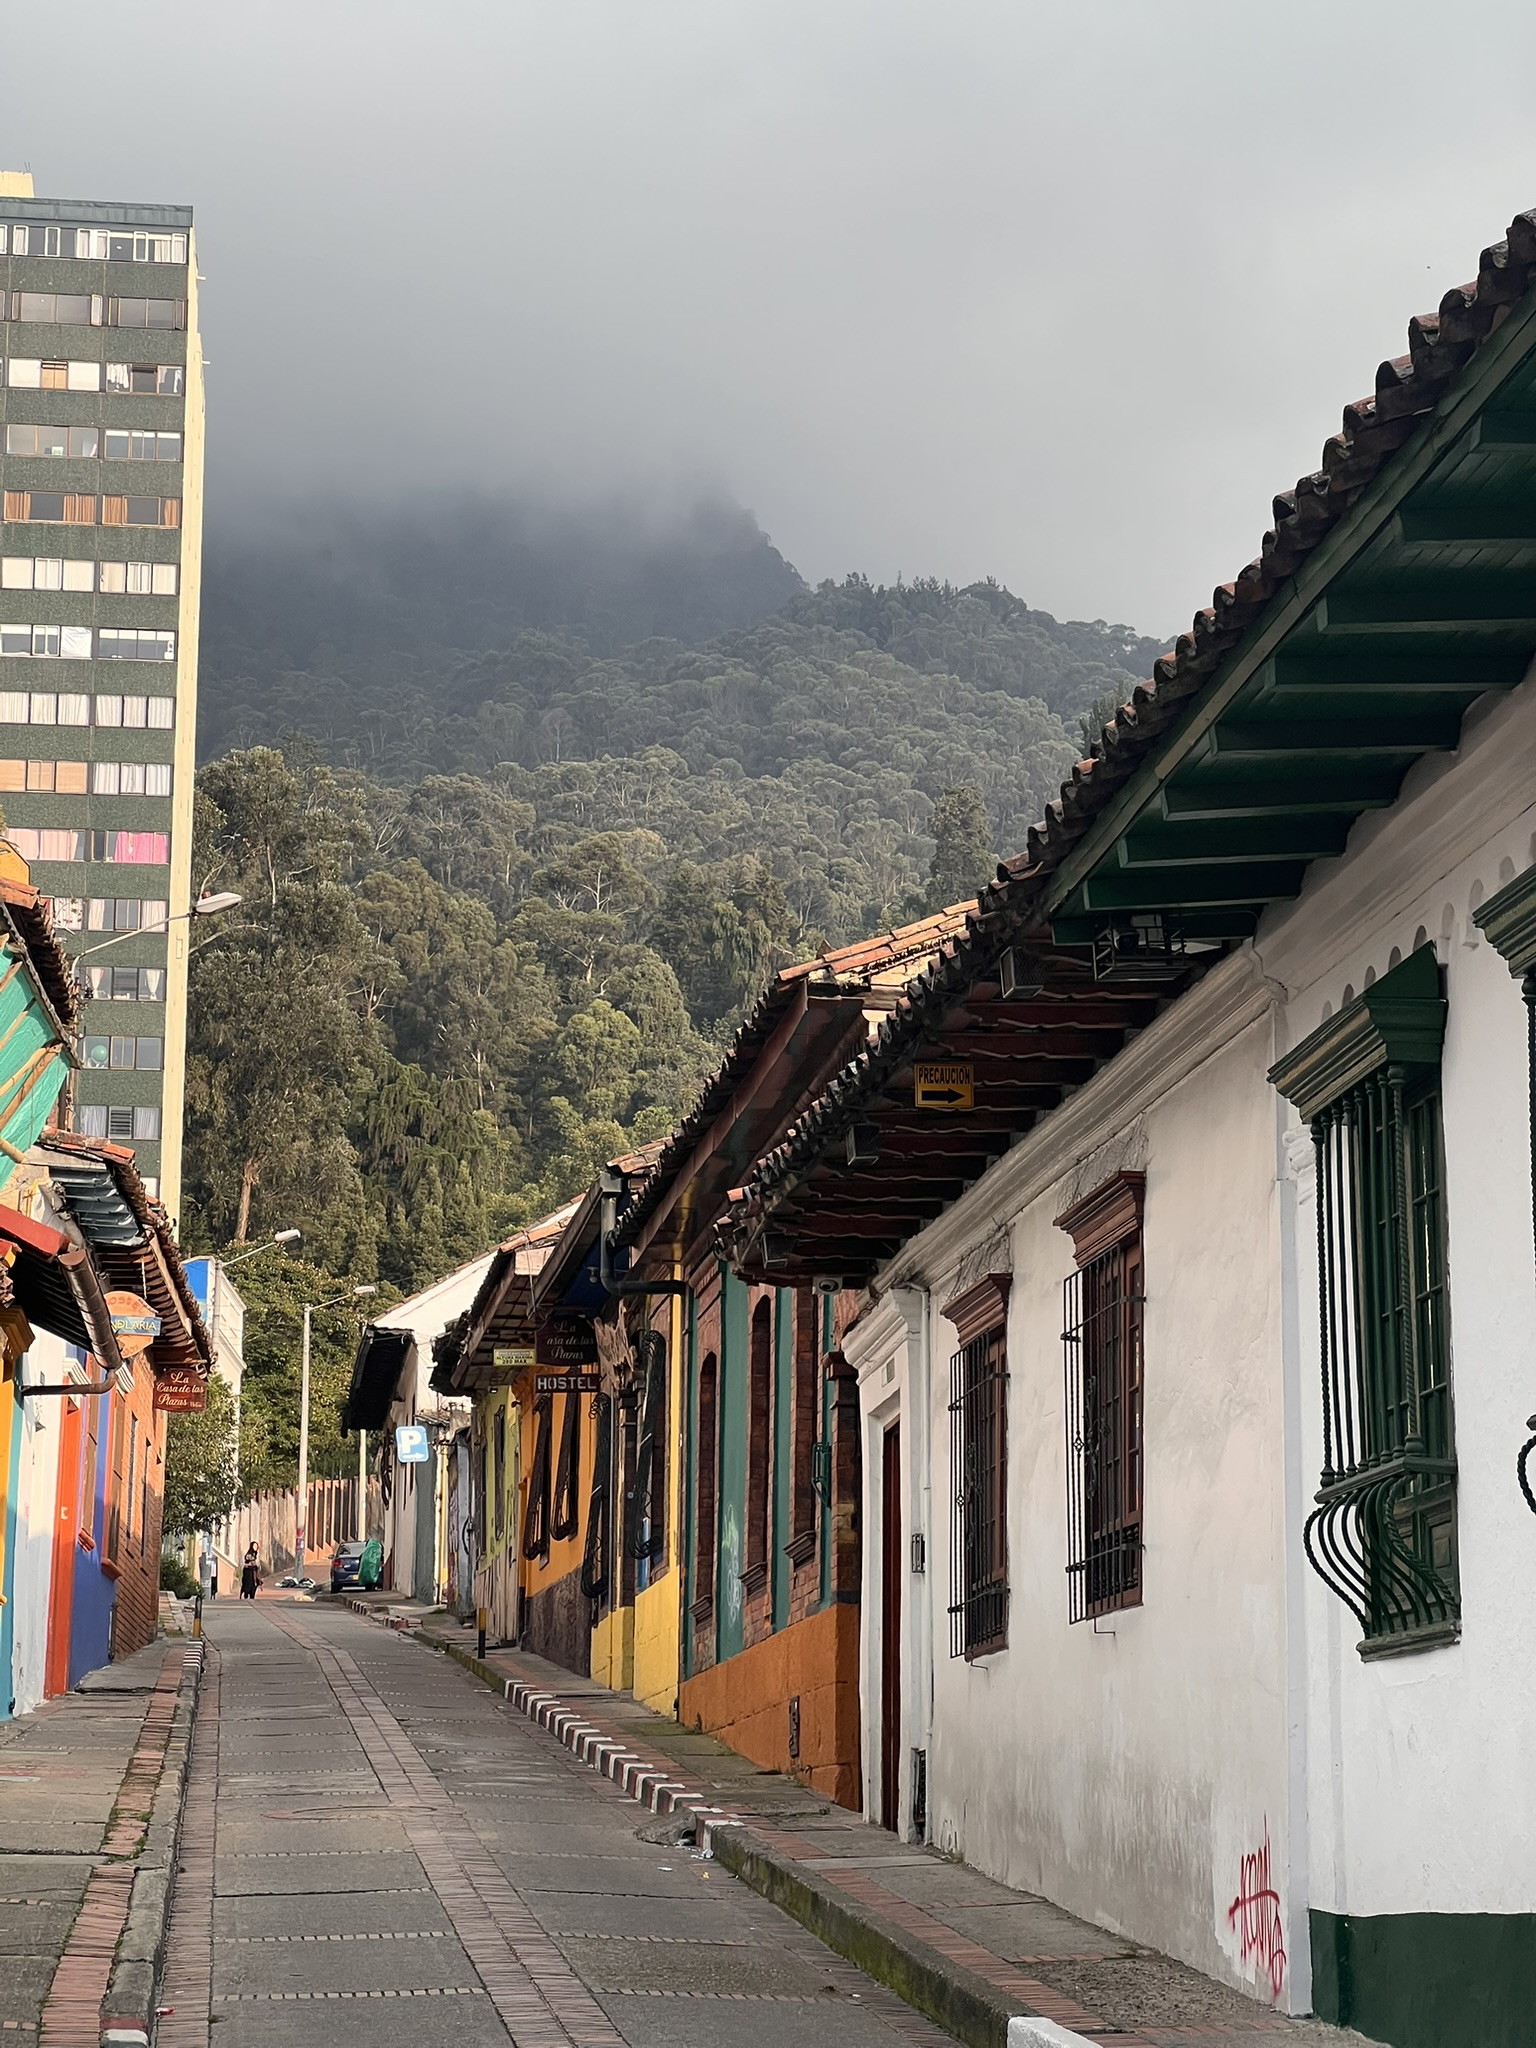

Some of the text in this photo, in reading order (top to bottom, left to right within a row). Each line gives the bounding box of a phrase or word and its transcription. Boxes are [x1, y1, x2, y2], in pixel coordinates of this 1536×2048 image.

[170, 1371, 190, 1384] La
[537, 1377, 597, 1390] HOSTEL
[156, 1382, 204, 1393] Casa de las
[157, 1393, 187, 1406] Plazas
[400, 1430, 422, 1454] P
